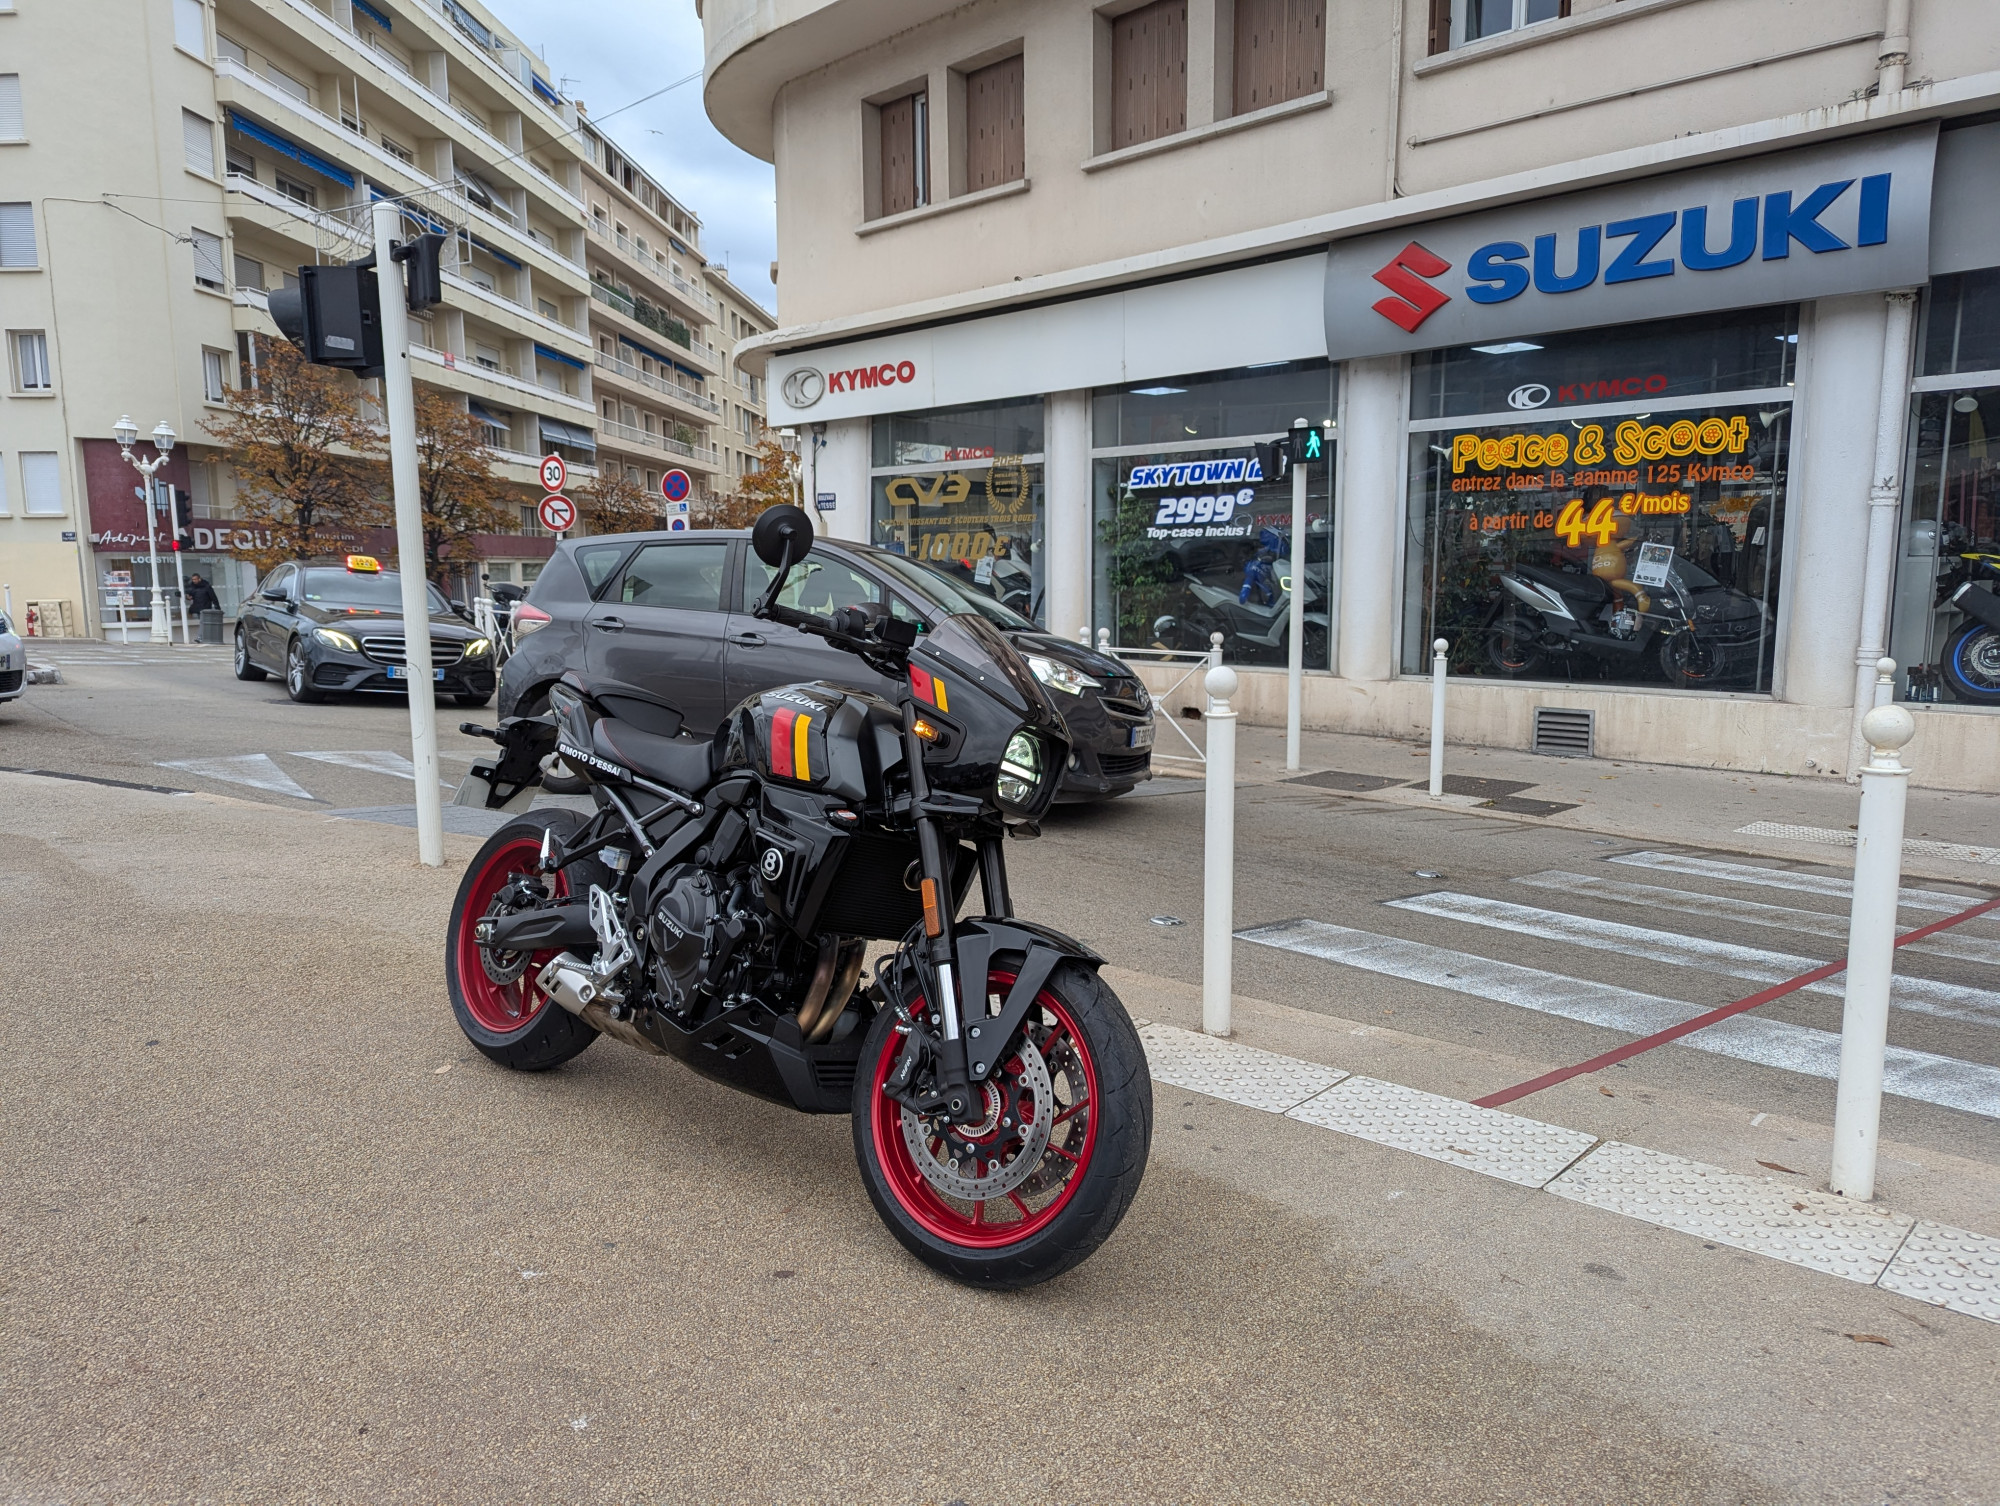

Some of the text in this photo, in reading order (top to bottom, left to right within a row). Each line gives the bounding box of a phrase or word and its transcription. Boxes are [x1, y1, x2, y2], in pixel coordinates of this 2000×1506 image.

[1465, 172, 1892, 304] SUZUKI
[828, 360, 916, 395] KYMCO
[1557, 374, 1668, 402] KYMCO
[944, 446, 995, 462] KYMCO
[1452, 416, 1749, 474] Peace & Scoot
[992, 454, 1024, 468] 2025
[546, 466, 561, 482] 30
[1130, 457, 1247, 490] SKYTOWN
[1451, 462, 1755, 493] entrez dans la gamme 125 Kymco
[939, 516, 952, 525] DES
[954, 515, 989, 525] SCOOTERS
[990, 514, 1012, 523] TROIS
[1256, 513, 1321, 526] KYMO
[1469, 511, 1479, 531] à
[1482, 510, 1529, 531] partir
[1533, 510, 1554, 528] de
[1146, 524, 1253, 541] Top-case inclus !
[910, 532, 1010, 561] -1000 €
[765, 691, 828, 712] SUZUKI
[565, 746, 621, 776] MOTO D'ESSAI
[764, 852, 777, 871] 8
[657, 911, 684, 939] SUZUKI
